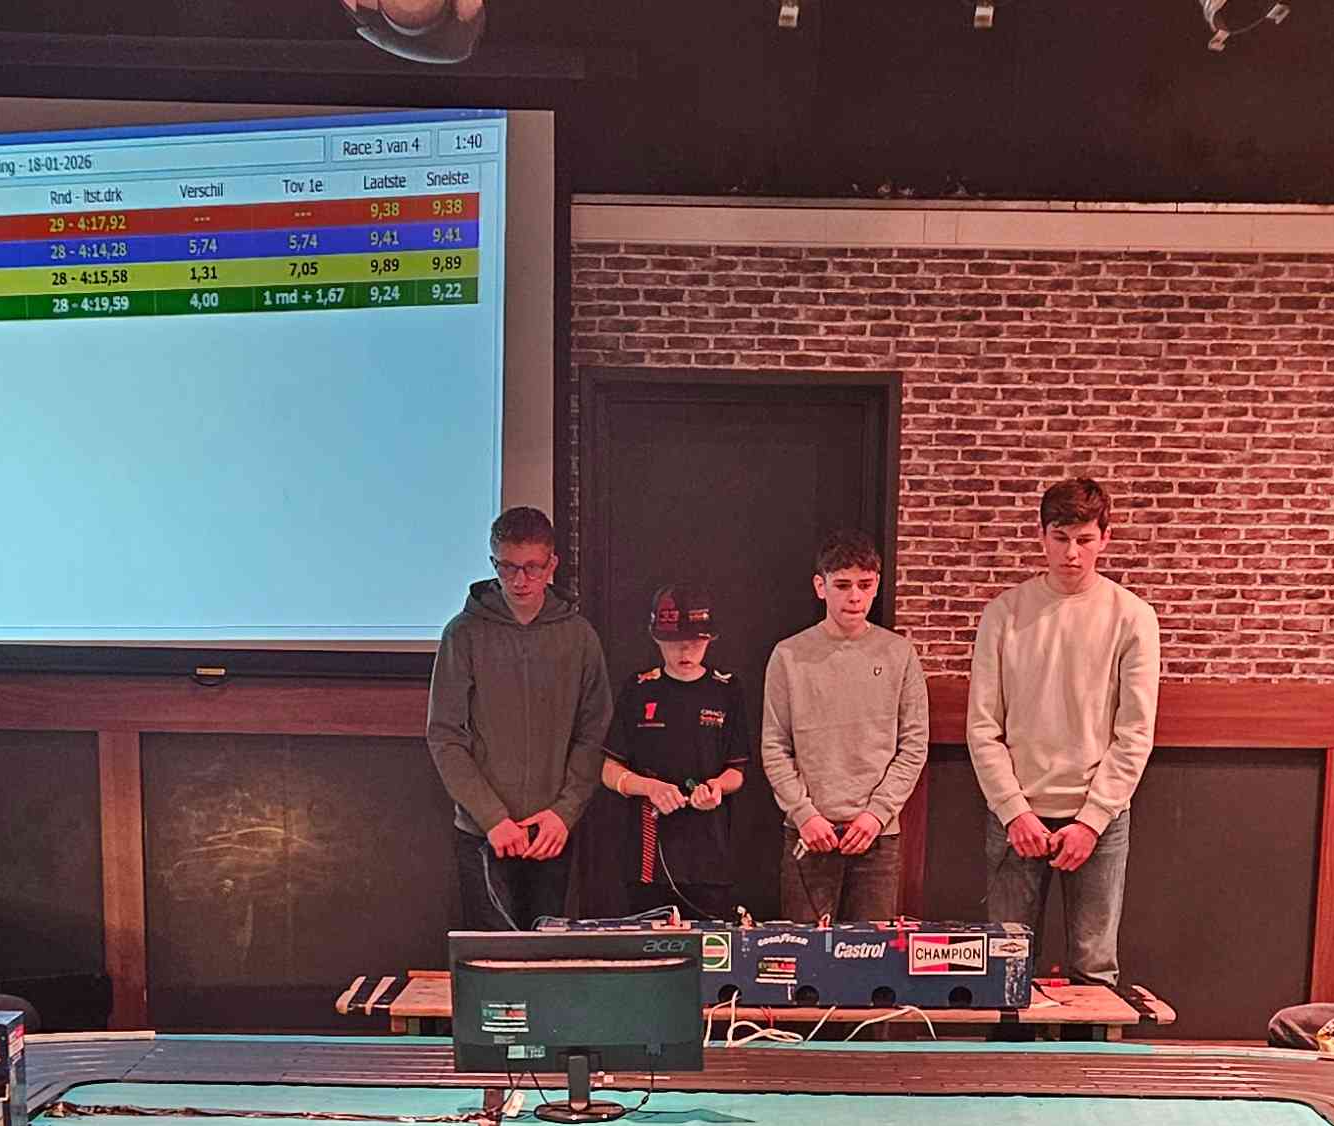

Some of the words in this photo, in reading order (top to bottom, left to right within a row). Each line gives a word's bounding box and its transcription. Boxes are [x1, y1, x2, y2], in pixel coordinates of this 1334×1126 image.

[343, 139, 371, 156] Race
[375, 139, 383, 154] 3
[387, 141, 408, 154] van
[411, 136, 420, 152] 4
[455, 134, 483, 150] 1:40
[27, 154, 92, 174] 18-01-2026
[50, 189, 72, 205] Rnd
[179, 183, 224, 199] Verschil
[283, 179, 304, 194] Tov
[309, 179, 323, 194] 1e
[363, 174, 407, 190] Laatste
[426, 171, 469, 187] Snelste
[49, 217, 66, 233] 29
[77, 215, 127, 233] 4:17,92
[370, 202, 400, 219] 9,38
[432, 199, 463, 216] 9,38
[50, 244, 67, 259] 28
[78, 241, 128, 259] 4:14,28
[189, 238, 218, 256] 5,74
[288, 233, 317, 251] 5,74
[370, 231, 400, 248] 9,41
[432, 227, 463, 243] 9,41
[51, 272, 67, 287] 28
[79, 269, 128, 287] 4:15,58
[189, 266, 218, 283] 1,31
[289, 261, 318, 278] 7,05
[370, 258, 400, 275] 9,89
[432, 255, 462, 272] 9,89
[52, 298, 69, 313] 28
[80, 296, 130, 313] 4:19,59
[189, 292, 219, 309] 4,00
[264, 290, 272, 305] 1
[315, 287, 345, 305] 1,67
[370, 284, 401, 301] 9,24
[432, 282, 463, 299] 9,22
[643, 939, 692, 953] acer
[834, 941, 886, 959] Castrol
[915, 947, 982, 961] CHAMPION
